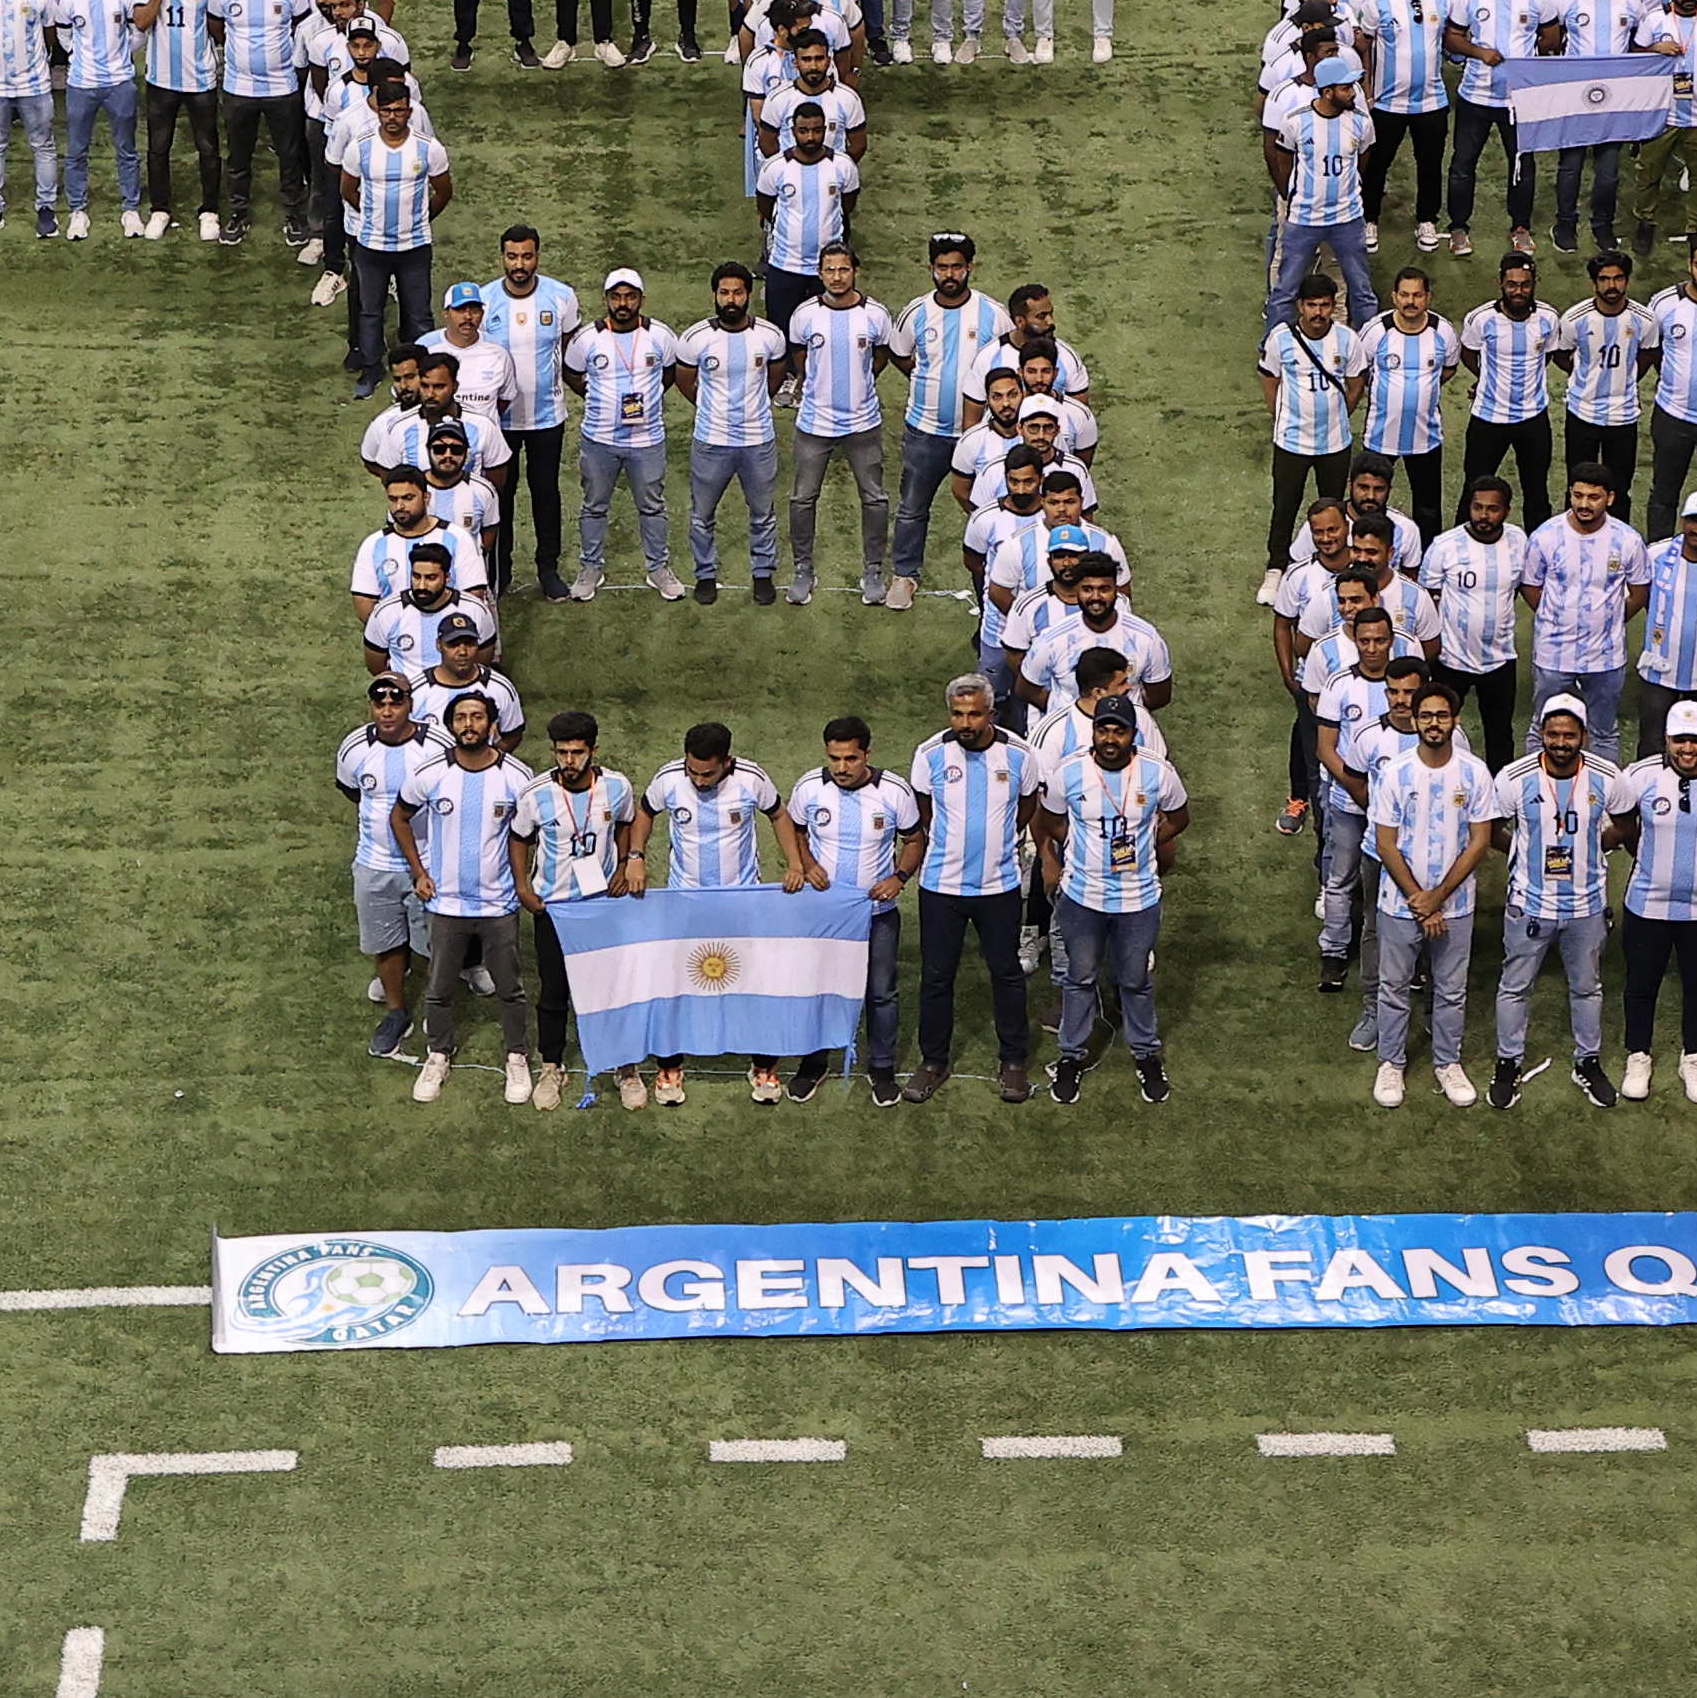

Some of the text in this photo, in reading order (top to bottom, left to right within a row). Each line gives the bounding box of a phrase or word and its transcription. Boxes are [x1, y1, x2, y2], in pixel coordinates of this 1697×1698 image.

[165, 5, 186, 28] 11
[1322, 153, 1344, 179] 10
[1598, 343, 1621, 369] 10
[1456, 571, 1477, 591] 10
[1553, 809, 1579, 836] 10
[569, 832, 597, 857] 10
[247, 1243, 373, 1310] ARGENTINA FANS
[455, 1251, 1223, 1318] ARGENTINA
[1227, 1243, 1581, 1302] FANS
[331, 1303, 417, 1342] QATAR
